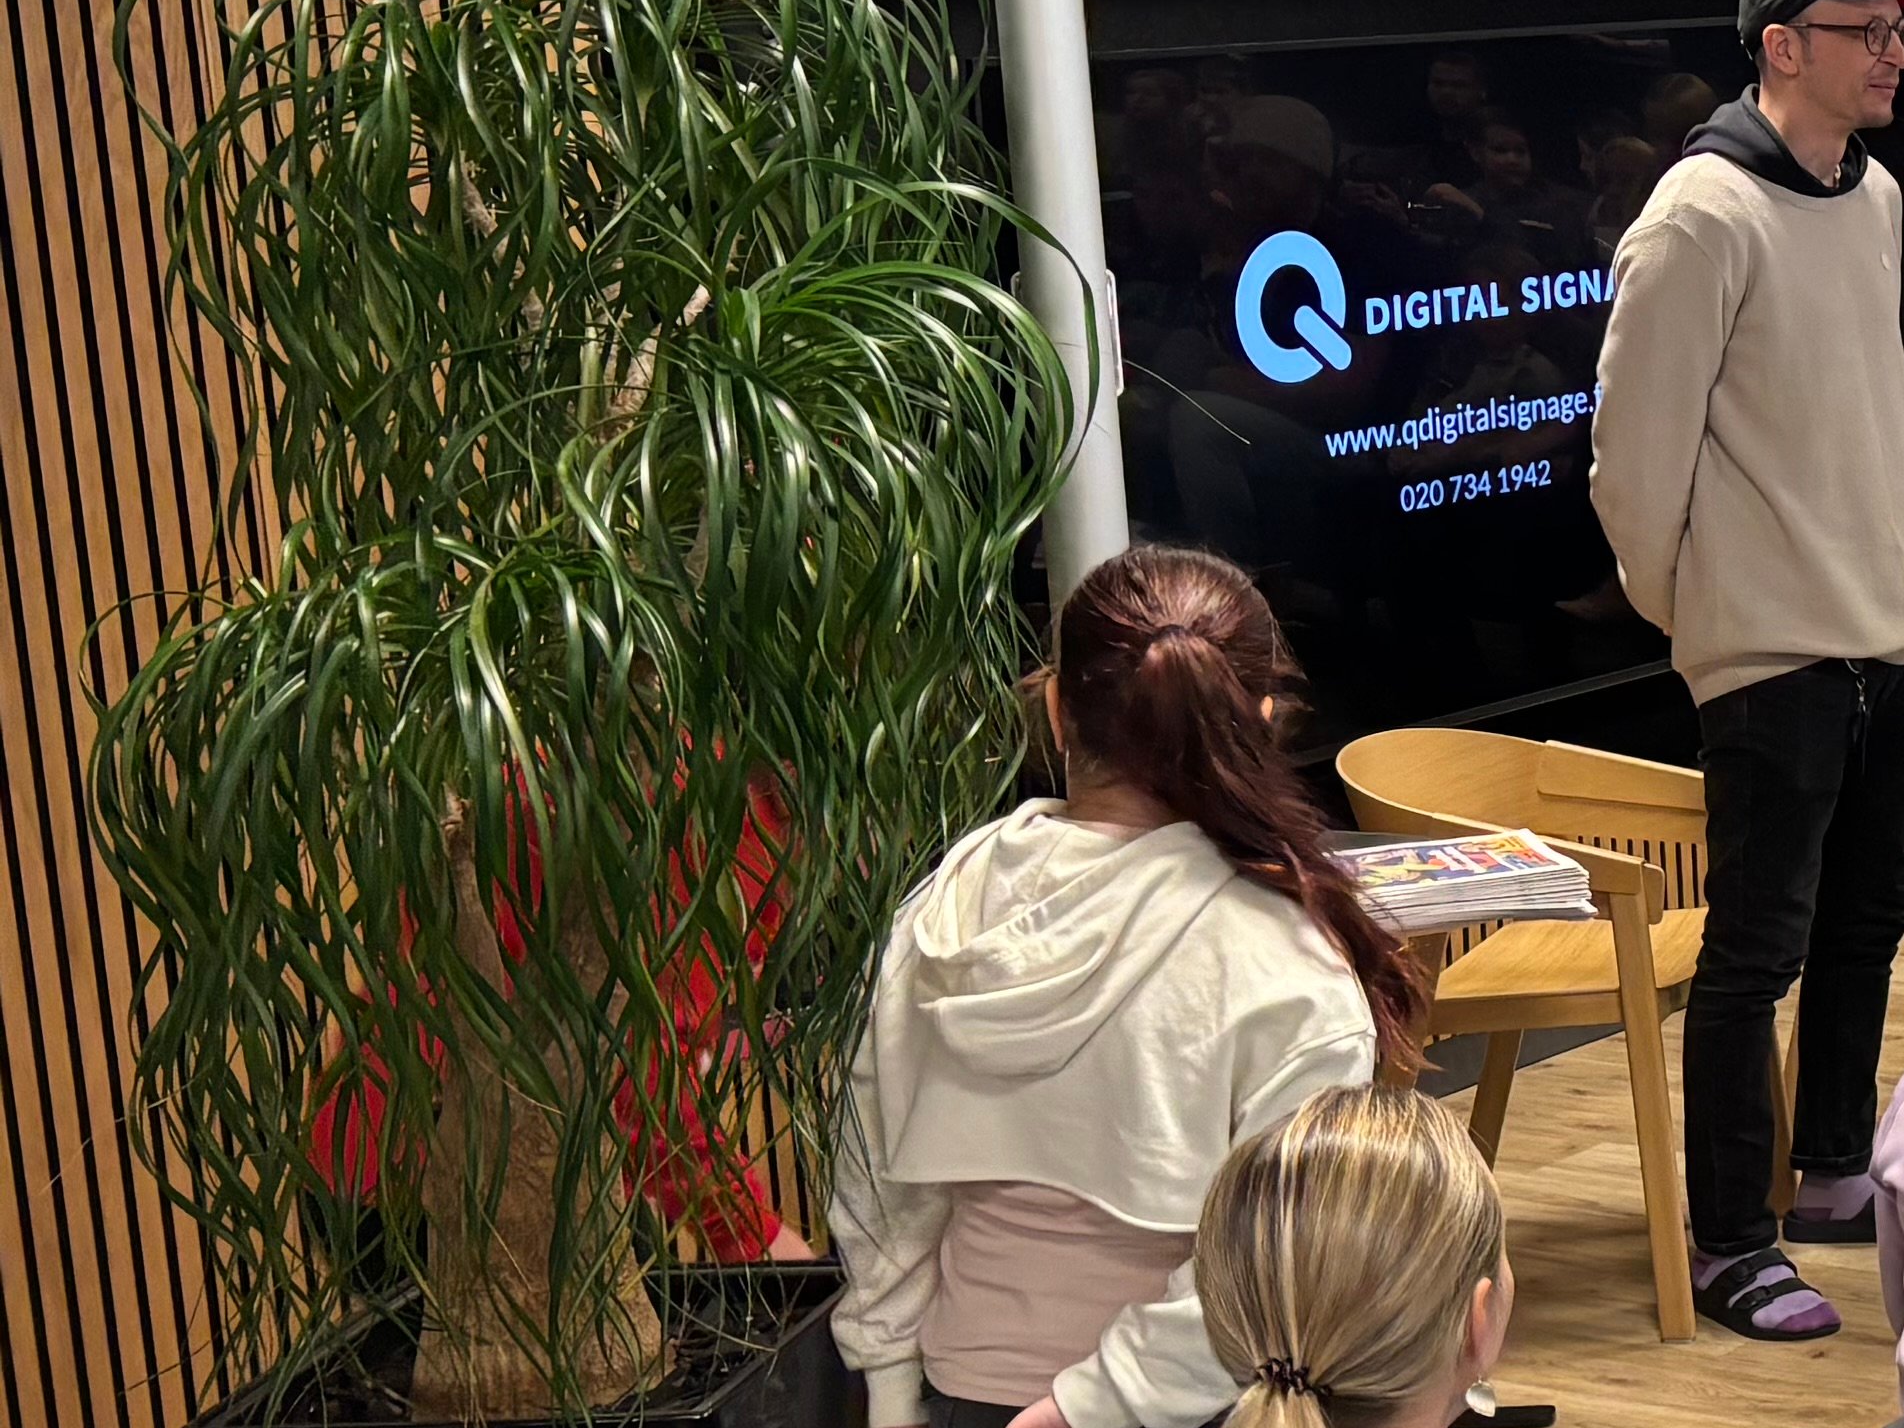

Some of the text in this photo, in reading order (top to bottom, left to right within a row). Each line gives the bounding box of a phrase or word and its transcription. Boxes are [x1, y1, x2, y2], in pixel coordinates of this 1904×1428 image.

[1365, 282, 1509, 335] DIGITAL
[1400, 460, 1552, 512] 020 734 1942
